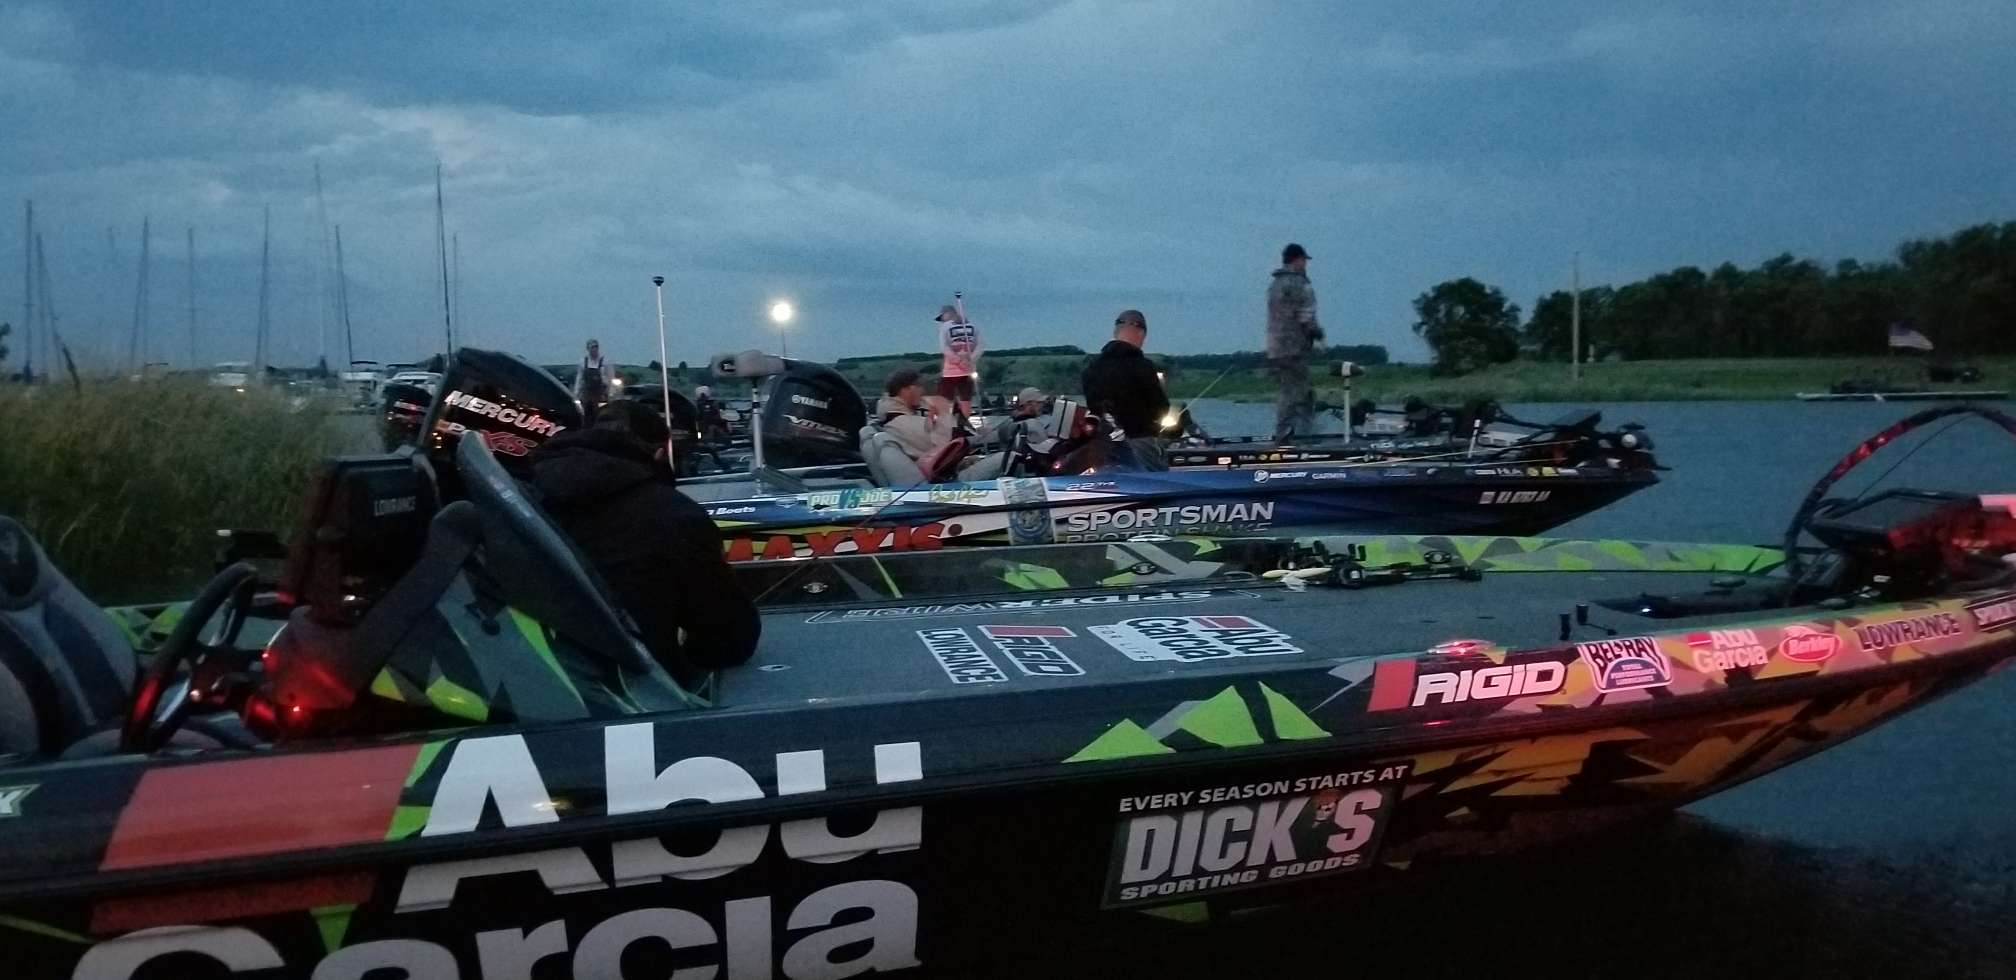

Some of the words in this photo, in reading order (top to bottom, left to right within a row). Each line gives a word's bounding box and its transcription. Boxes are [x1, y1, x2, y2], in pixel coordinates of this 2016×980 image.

[445, 391, 567, 438] MERCURY
[717, 505, 756, 515] Boats
[1067, 501, 1275, 532] SPORTSMAN
[921, 618, 1000, 683] LOWRANCE
[1126, 617, 1231, 660] Garcia
[1199, 628, 1292, 655] Abu
[1711, 628, 1759, 650] Abu
[1854, 612, 1962, 651] LOWRANCE
[994, 635, 1083, 675] RIGID
[1693, 644, 1769, 674] Garcia
[1412, 661, 1567, 707] RIGID
[1119, 790, 1194, 812] EVERY
[1199, 780, 1290, 804] SEASON
[1293, 769, 1375, 792] STARTS
[1379, 765, 1408, 781] AT
[395, 722, 922, 915] Abu
[1120, 869, 1259, 900] SPORTING
[1268, 853, 1361, 879] GOODS
